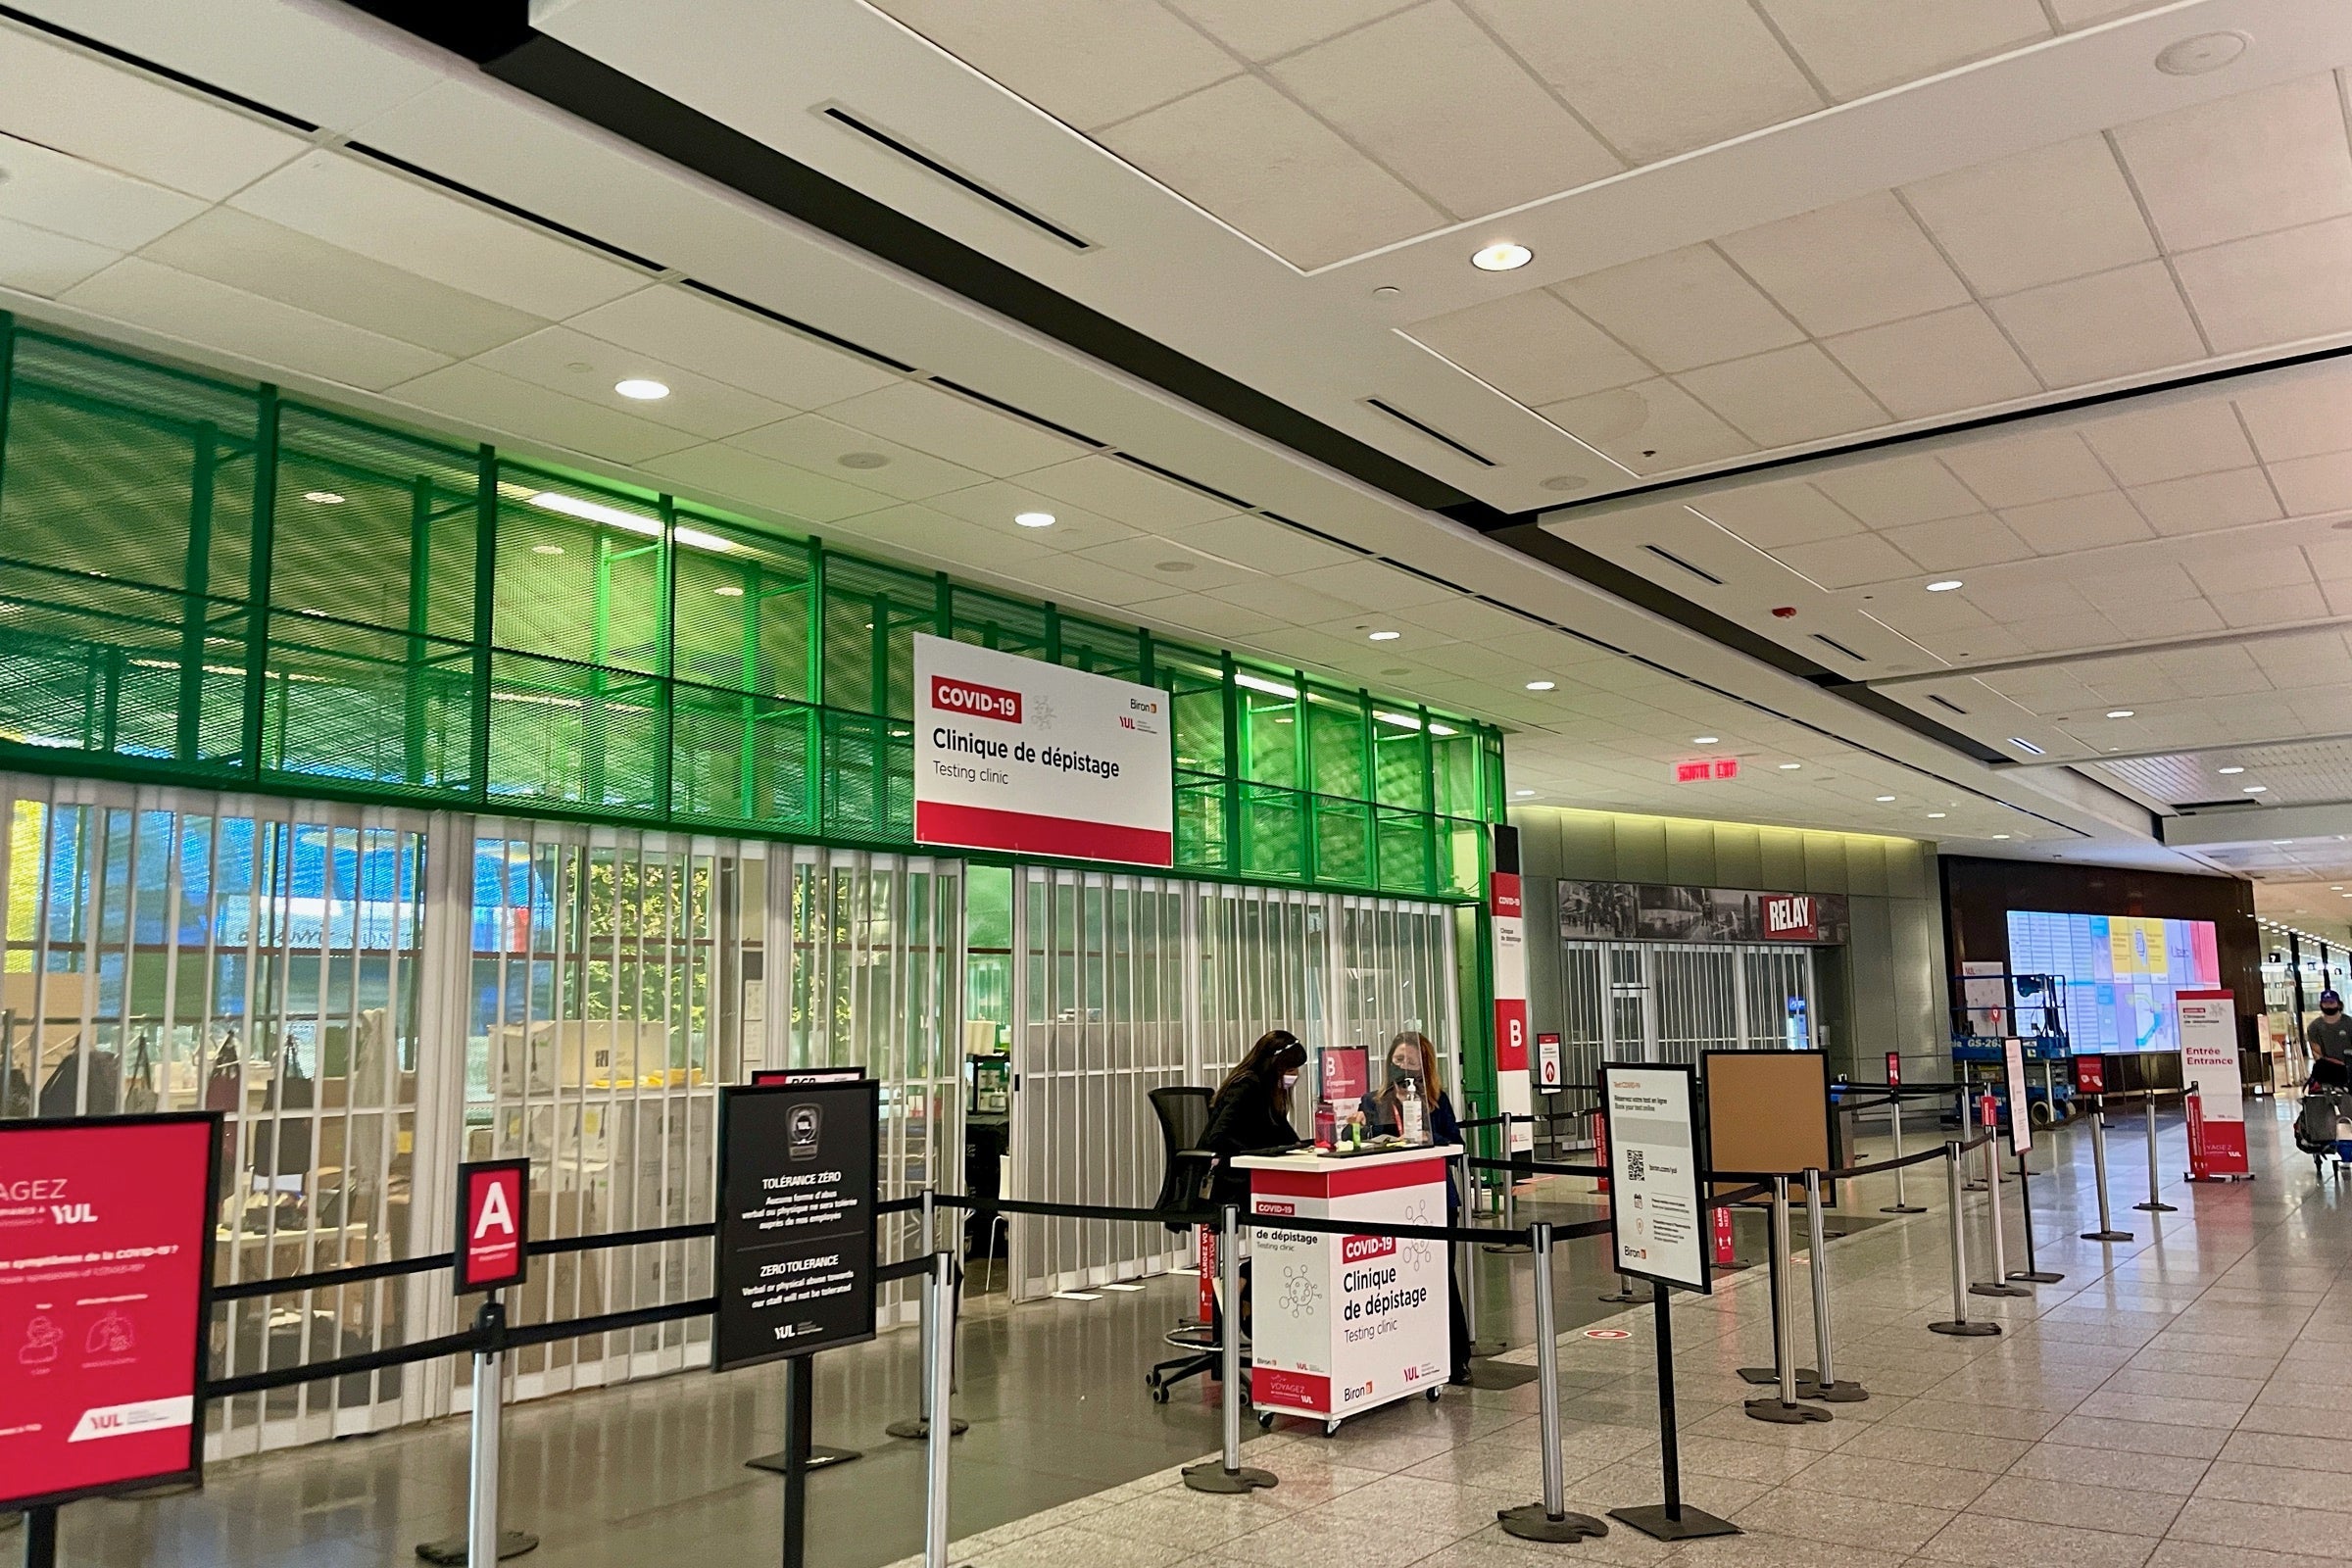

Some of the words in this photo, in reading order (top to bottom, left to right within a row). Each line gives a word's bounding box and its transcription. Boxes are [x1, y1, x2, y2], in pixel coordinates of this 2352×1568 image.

[938, 686, 1015, 716] COVID-19
[1131, 699, 1150, 711] Biron
[1119, 716, 1135, 729] YUL
[933, 728, 1008, 759] Clinique
[1014, 742, 1036, 762] de
[1042, 747, 1119, 778] dépistage
[933, 760, 975, 782] Testing
[980, 767, 1008, 784] clinic
[1769, 897, 1808, 931] RELAY
[1509, 1019, 1522, 1048] B
[1326, 1056, 1336, 1077] B
[762, 1175, 816, 1190] TOLÉRANCE
[817, 1171, 842, 1183] ZÉRO
[50, 1203, 98, 1224] YUL
[474, 1181, 514, 1239] A
[1258, 1204, 1292, 1213] COVID-19
[1256, 1230, 1268, 1239] de
[1271, 1230, 1318, 1245] dépistage
[1257, 1242, 1278, 1250] Testing
[1346, 1237, 1393, 1258] COVID-19
[1625, 1246, 1640, 1257] Biron
[760, 1263, 786, 1277] ZERO
[787, 1254, 839, 1272] TOLERANCE
[1344, 1267, 1396, 1293] Clinique
[1345, 1299, 1360, 1321] de
[1365, 1287, 1427, 1315] dépistage
[774, 1324, 796, 1340] YUL
[1345, 1326, 1375, 1344] Testing
[1377, 1318, 1397, 1335] clinic
[1403, 1366, 1420, 1382] YUL
[1345, 1385, 1365, 1401] Biron
[90, 1414, 123, 1429] YUL
